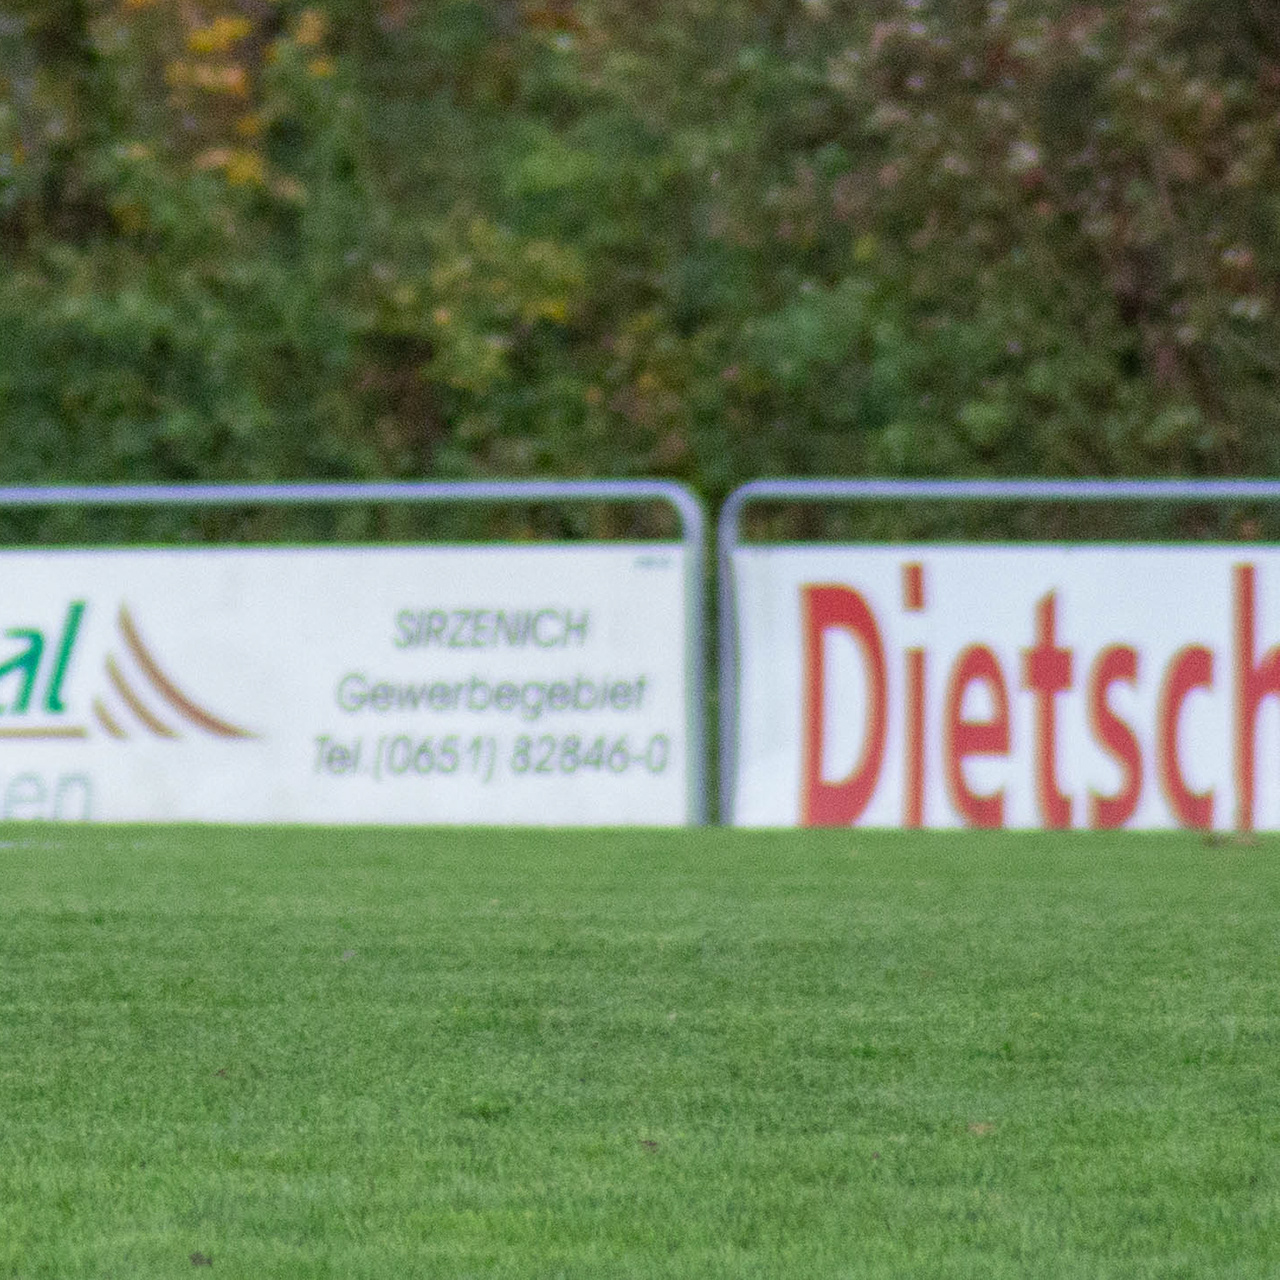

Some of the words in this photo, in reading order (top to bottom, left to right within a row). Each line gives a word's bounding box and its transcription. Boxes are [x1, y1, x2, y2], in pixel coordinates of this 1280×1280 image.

[393, 609, 590, 648] SIRZENICH
[338, 672, 647, 720] Gewerbegebiet
[512, 733, 670, 773] 82846-0
